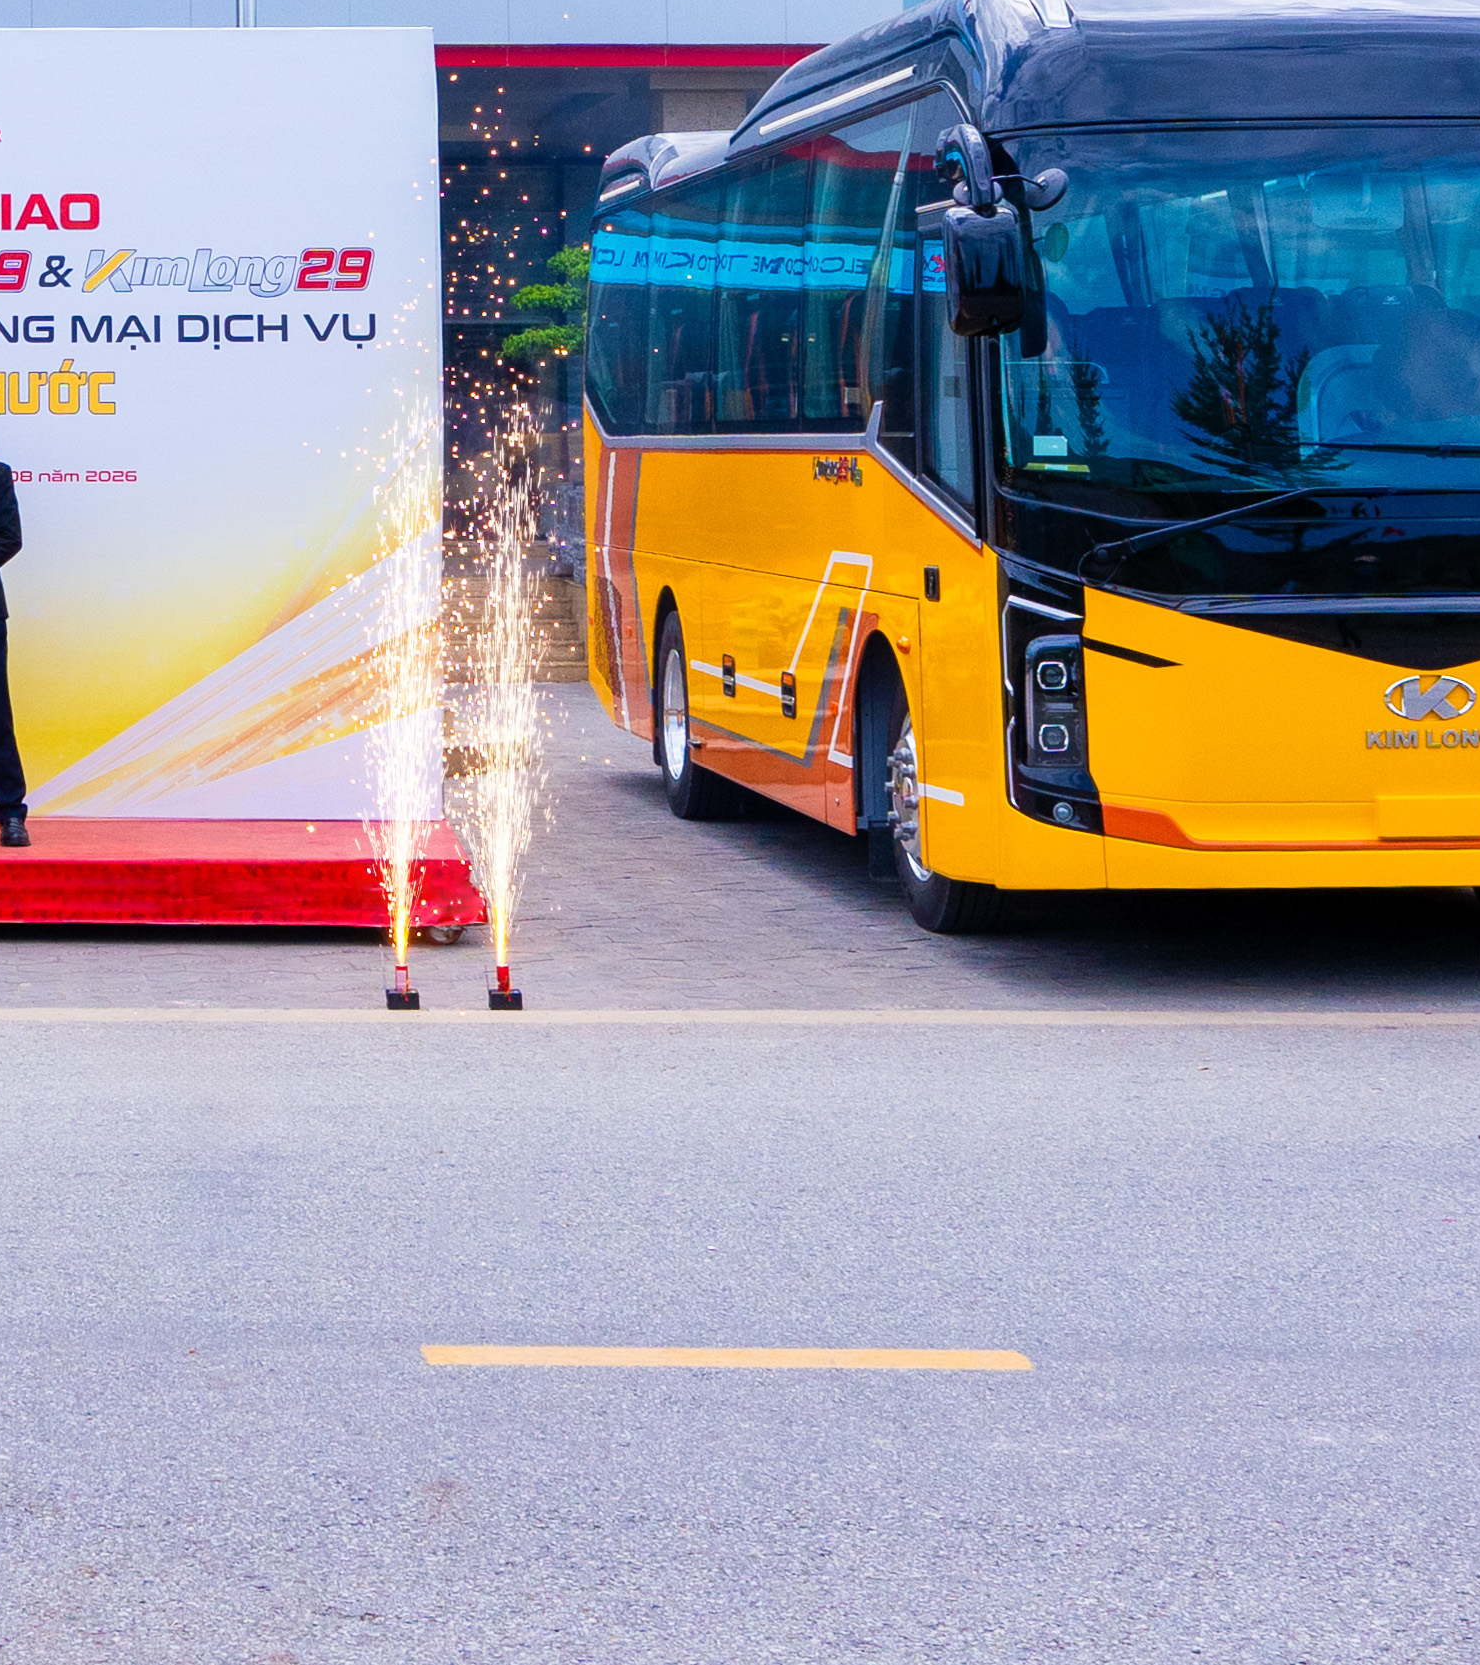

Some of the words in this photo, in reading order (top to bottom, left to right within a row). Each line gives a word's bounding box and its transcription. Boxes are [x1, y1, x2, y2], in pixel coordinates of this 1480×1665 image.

[38, 254, 75, 288] &
[70, 314, 161, 351] MẠI
[177, 313, 288, 351] DỊCH
[303, 312, 377, 350] VỤ
[38, 469, 80, 483] năm
[85, 470, 138, 483] 2026
[1366, 729, 1419, 749] KIM
